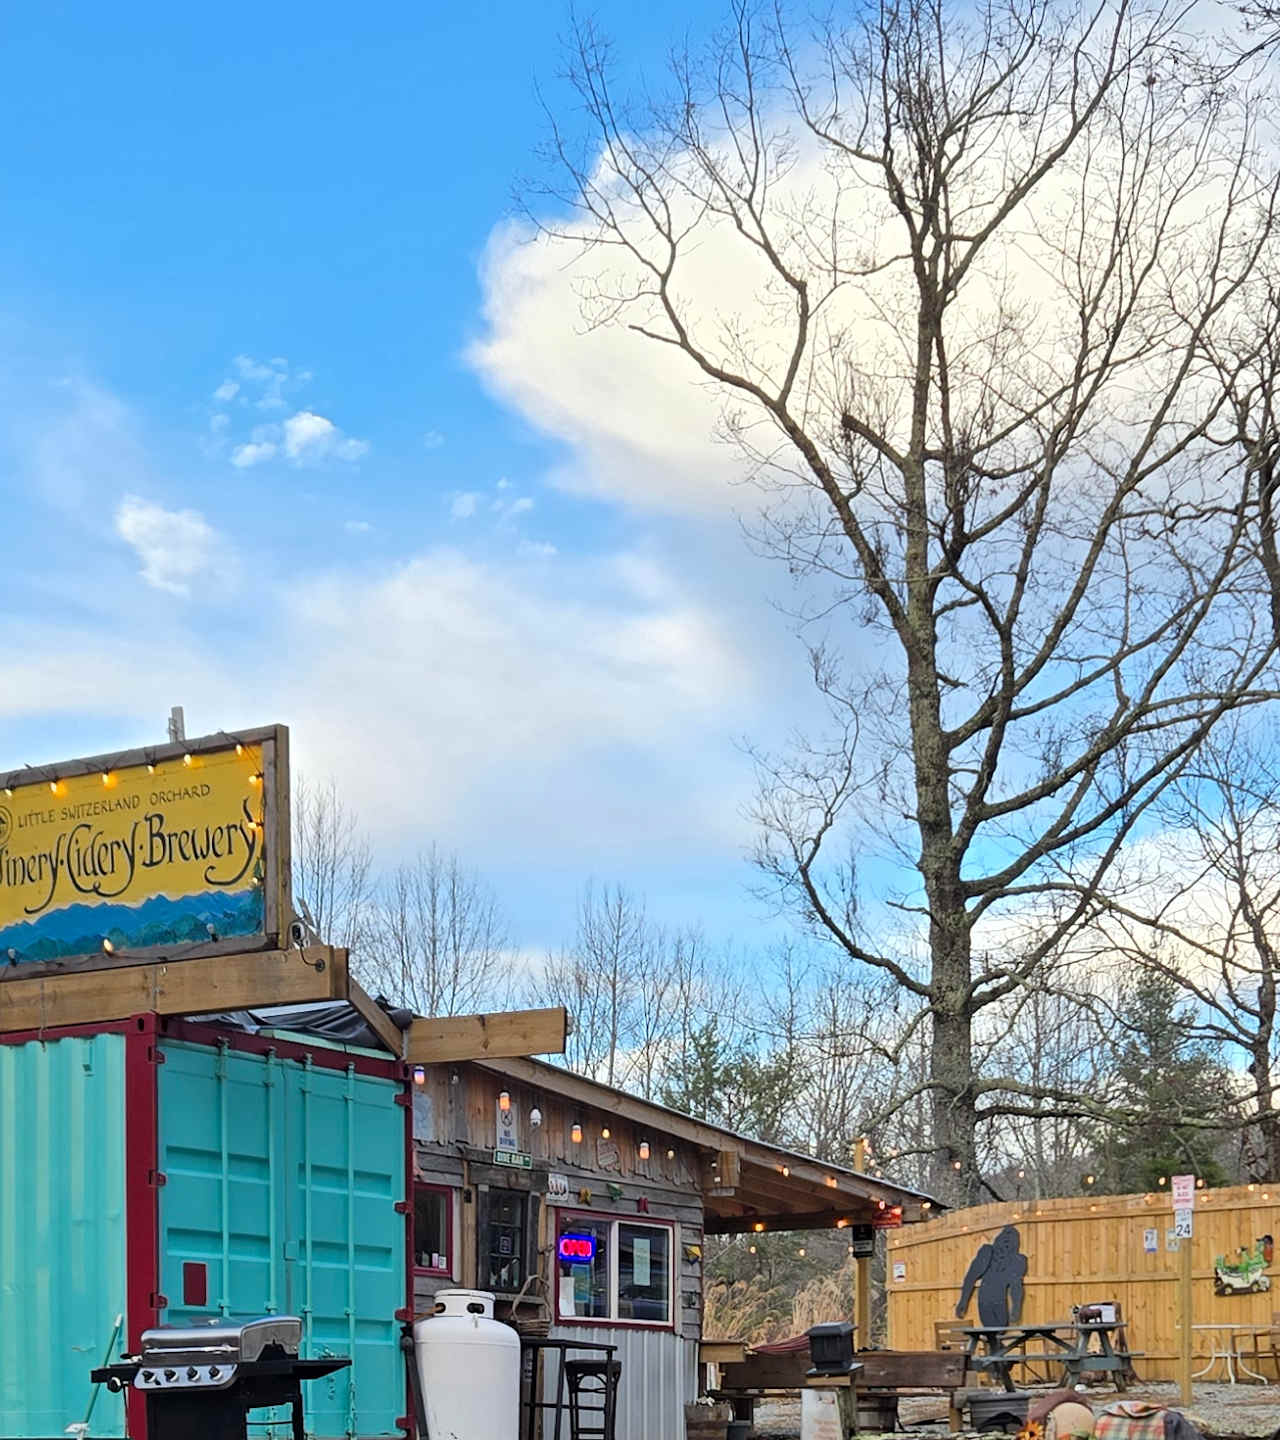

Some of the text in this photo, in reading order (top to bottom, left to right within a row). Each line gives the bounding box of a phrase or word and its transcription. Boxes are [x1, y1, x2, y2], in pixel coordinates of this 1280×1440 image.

[18, 783, 211, 828] LITTLE SWITZERLAND ORCHARD
[67, 820, 142, 898] Cidery
[142, 796, 256, 886] Brewery
[1176, 1224, 1191, 1237] 24
[561, 1239, 592, 1256] OPEN
